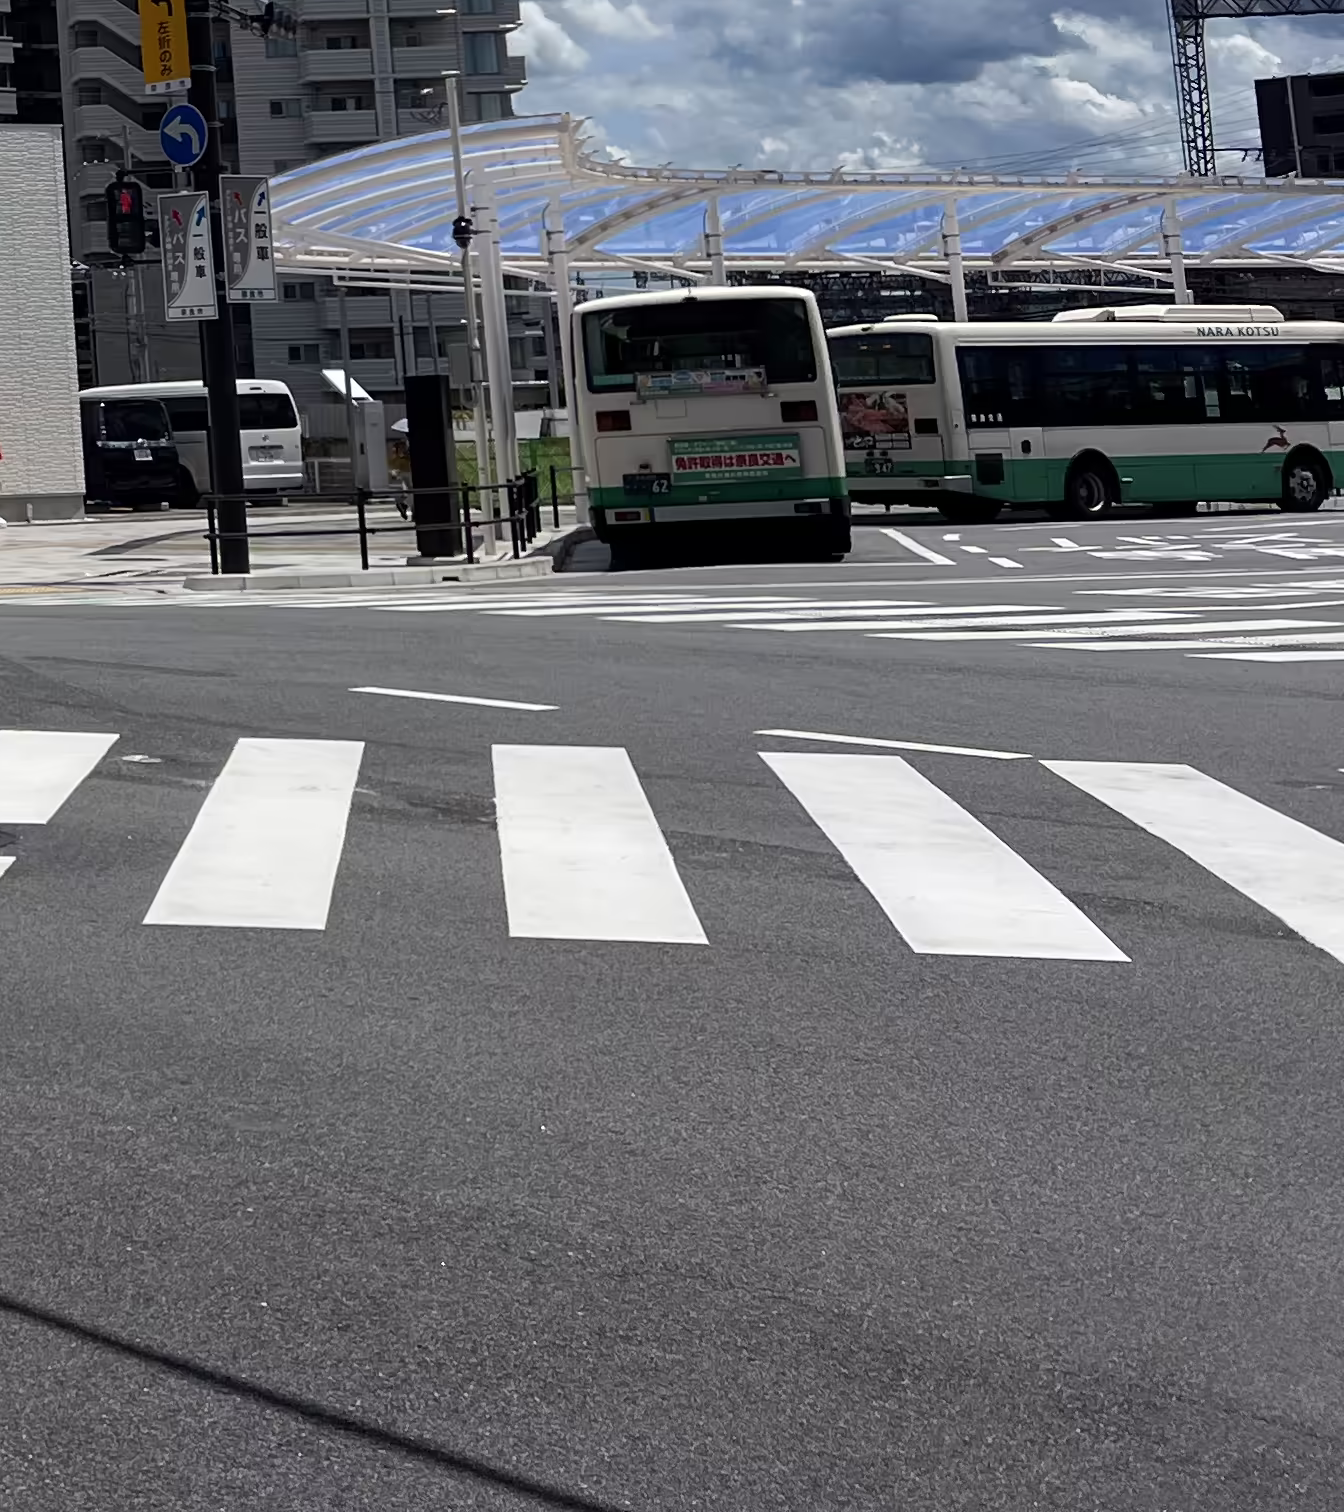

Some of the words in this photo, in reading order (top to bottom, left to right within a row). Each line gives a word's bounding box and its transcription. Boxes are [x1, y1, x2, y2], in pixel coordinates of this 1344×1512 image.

[157, 21, 173, 76] 左折のみ
[192, 233, 207, 278] 一般車
[254, 210, 269, 261] 一般車
[1196, 327, 1234, 337] NARA
[1236, 327, 1279, 337] KOTSU
[652, 479, 669, 493] 62
